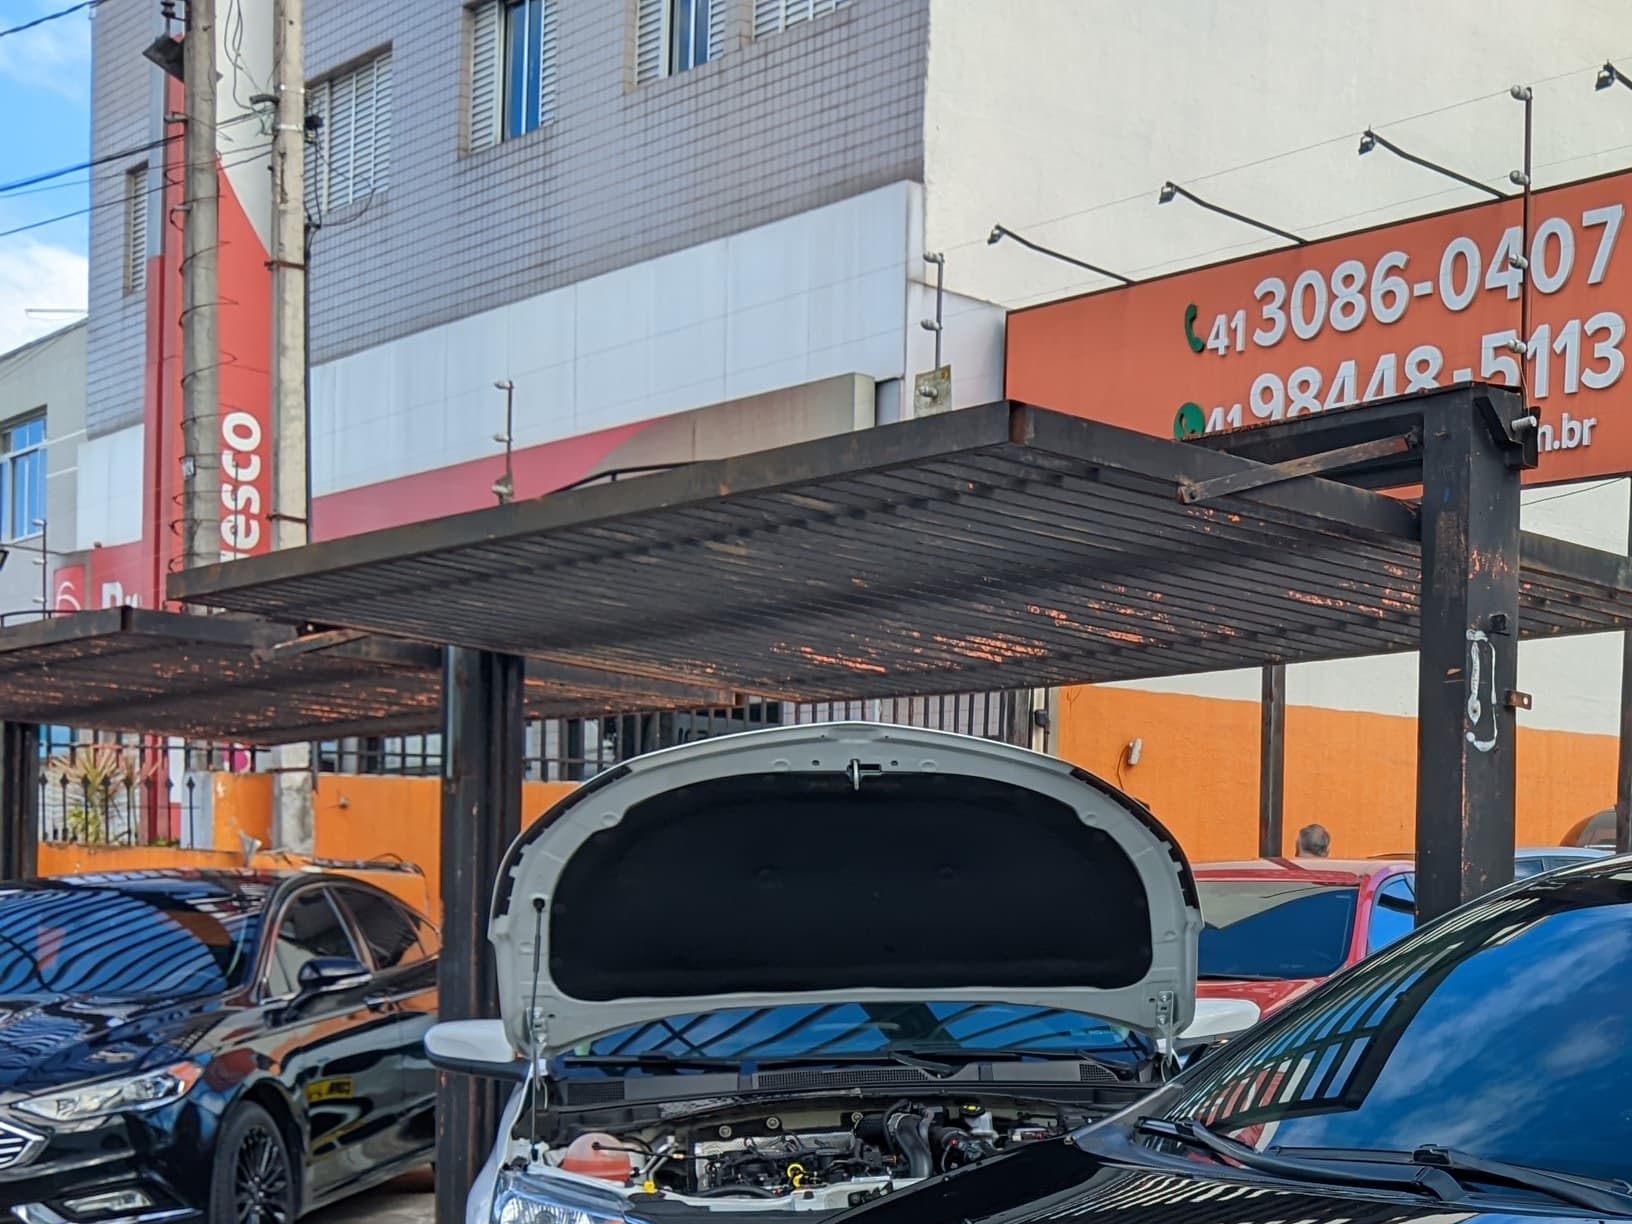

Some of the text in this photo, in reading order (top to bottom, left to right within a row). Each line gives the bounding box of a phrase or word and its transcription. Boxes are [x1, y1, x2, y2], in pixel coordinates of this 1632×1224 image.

[1206, 203, 1626, 357] 41 3086-0407
[1249, 312, 1626, 422] 98448-5113
[220, 411, 263, 562] esco
